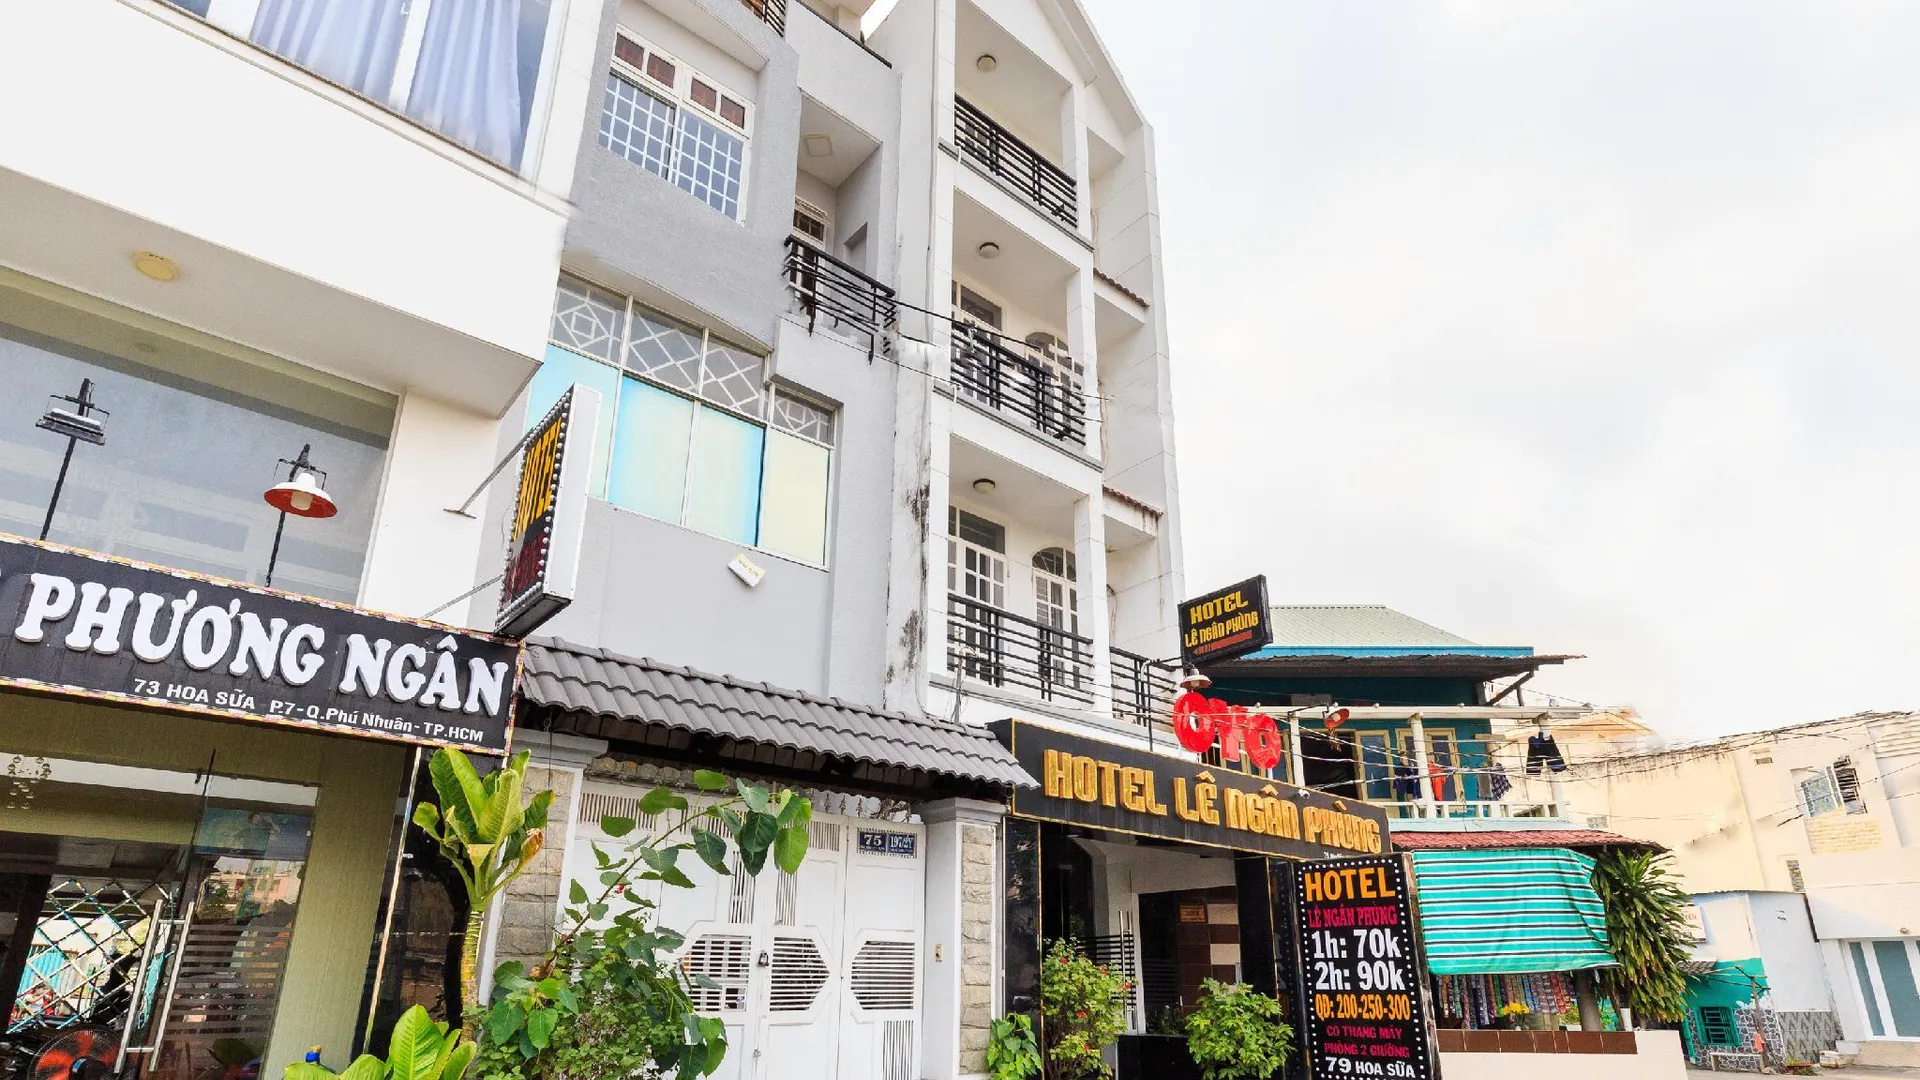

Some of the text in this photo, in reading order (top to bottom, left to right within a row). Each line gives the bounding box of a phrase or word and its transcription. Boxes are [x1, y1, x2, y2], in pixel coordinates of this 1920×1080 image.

[1190, 590, 1249, 625] HOTEL
[14, 571, 509, 717] PHƯƠNG NGÂN
[1184, 627, 1199, 649] LÊ
[134, 678, 160, 695] 73
[166, 683, 209, 703] HOA
[215, 689, 256, 710] SỮA
[1043, 748, 1168, 817] HOTEL
[1173, 770, 1220, 826] LÊ
[863, 834, 883, 847] 75
[1304, 867, 1396, 902] HOTEL
[1307, 903, 1322, 928] LÊ
[1323, 903, 1355, 927] NGÂN
[1311, 928, 1402, 959] 1h: 70k
[1314, 960, 1406, 991] 2h: 90k
[1336, 993, 1411, 1021] 200-250-300
[1342, 1026, 1376, 1039] THANG
[1360, 1044, 1368, 1056] 2
[1325, 1056, 1416, 1079] 79 HOA SỮA
